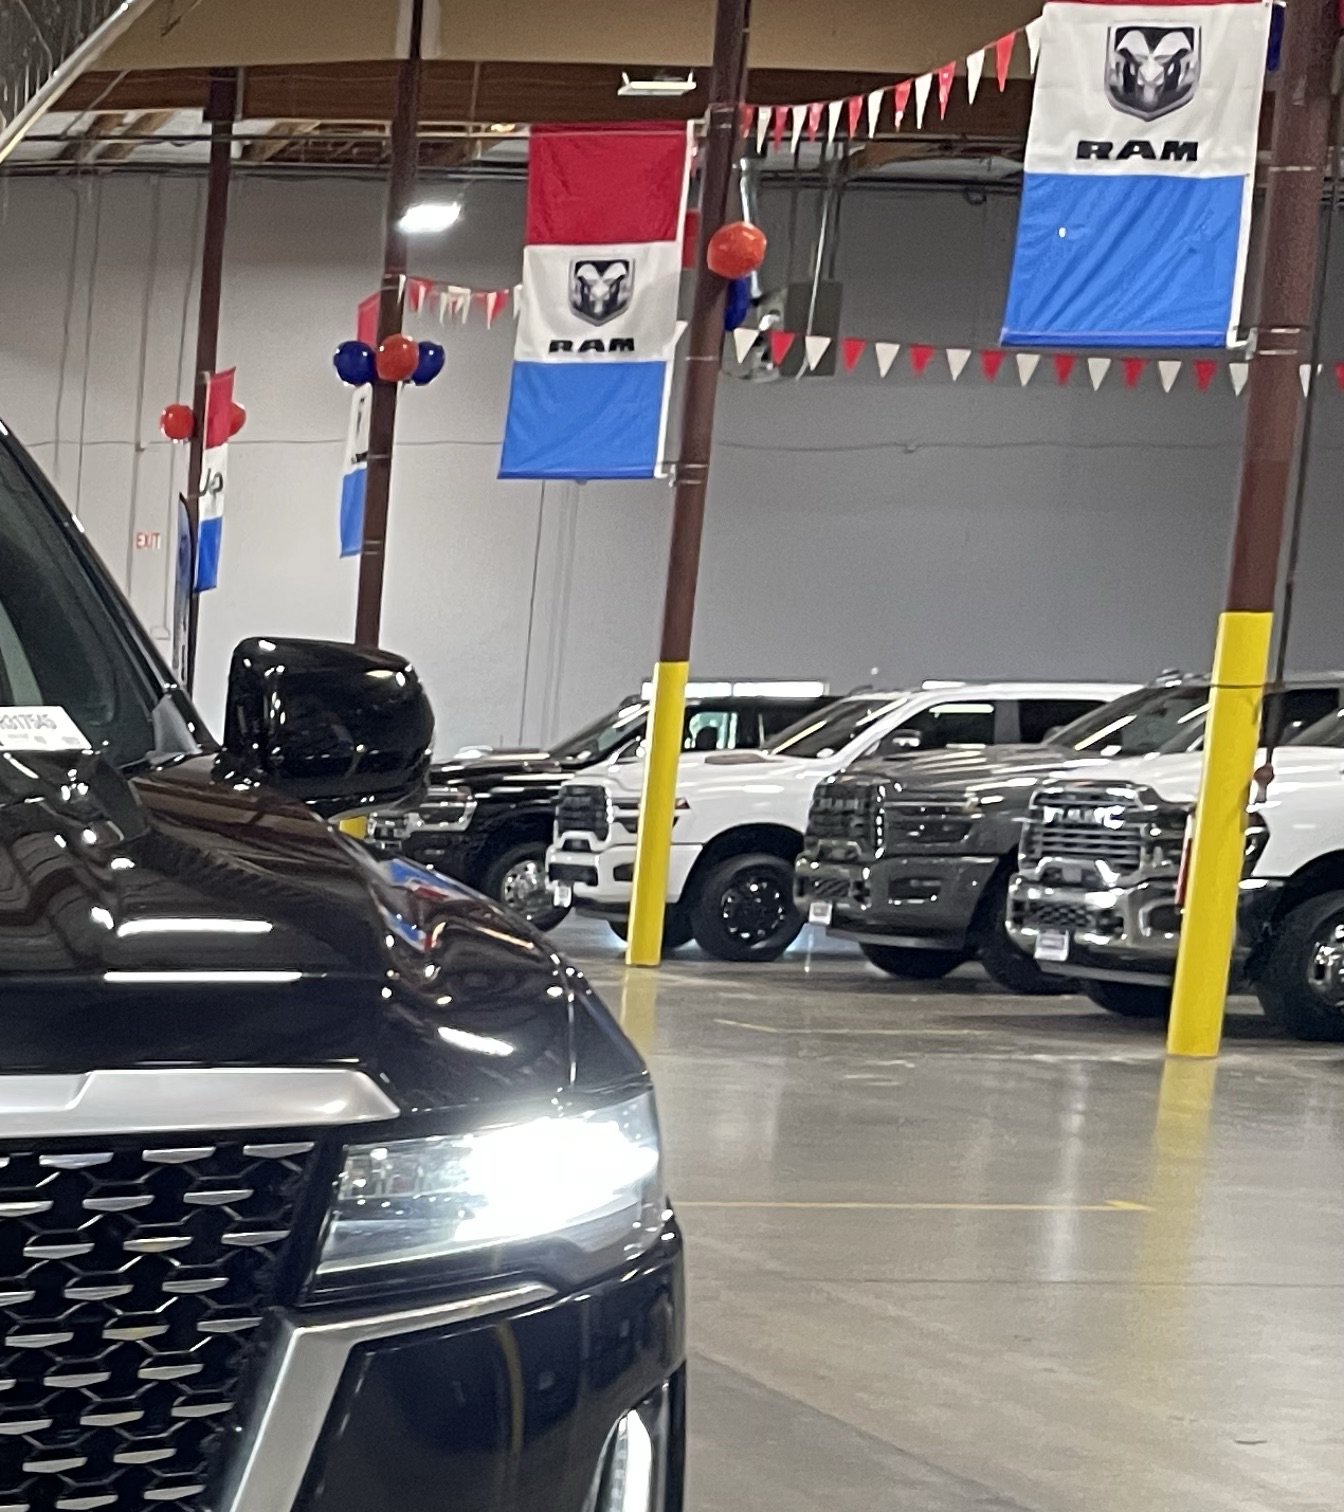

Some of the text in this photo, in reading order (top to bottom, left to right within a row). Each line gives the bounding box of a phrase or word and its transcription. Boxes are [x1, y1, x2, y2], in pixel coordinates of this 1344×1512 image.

[1076, 140, 1199, 161] RAM
[549, 338, 635, 353] RAM
[136, 532, 160, 549] EXIT
